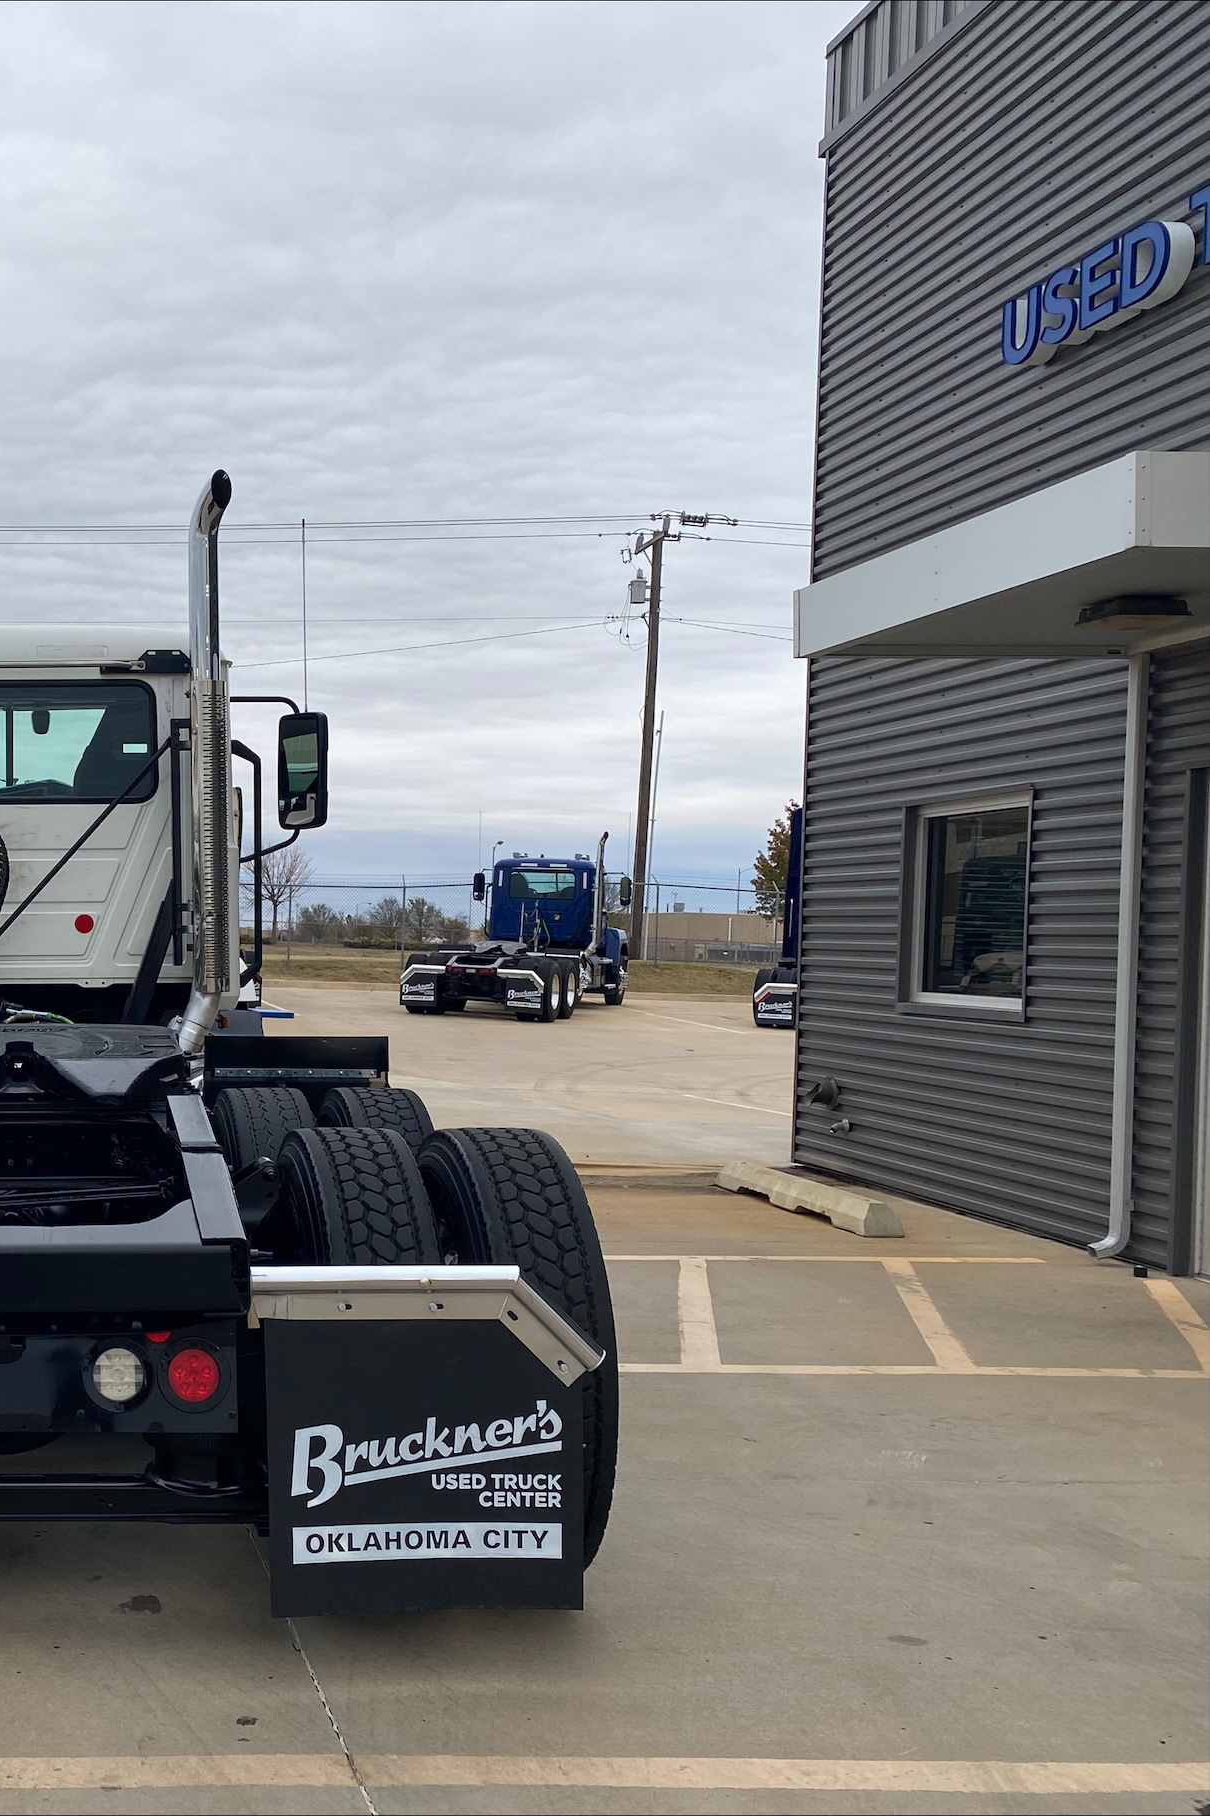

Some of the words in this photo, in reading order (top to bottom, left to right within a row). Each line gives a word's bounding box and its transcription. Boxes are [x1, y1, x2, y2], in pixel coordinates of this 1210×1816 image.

[1002, 221, 1175, 365] USED
[291, 1400, 563, 1508] Bruckner's
[432, 1474, 487, 1490] USED
[491, 1473, 562, 1490] TRUCK
[478, 1491, 562, 1508] CENTER
[305, 1530, 472, 1554] OKLAHOMA
[482, 1529, 550, 1550] CITY
